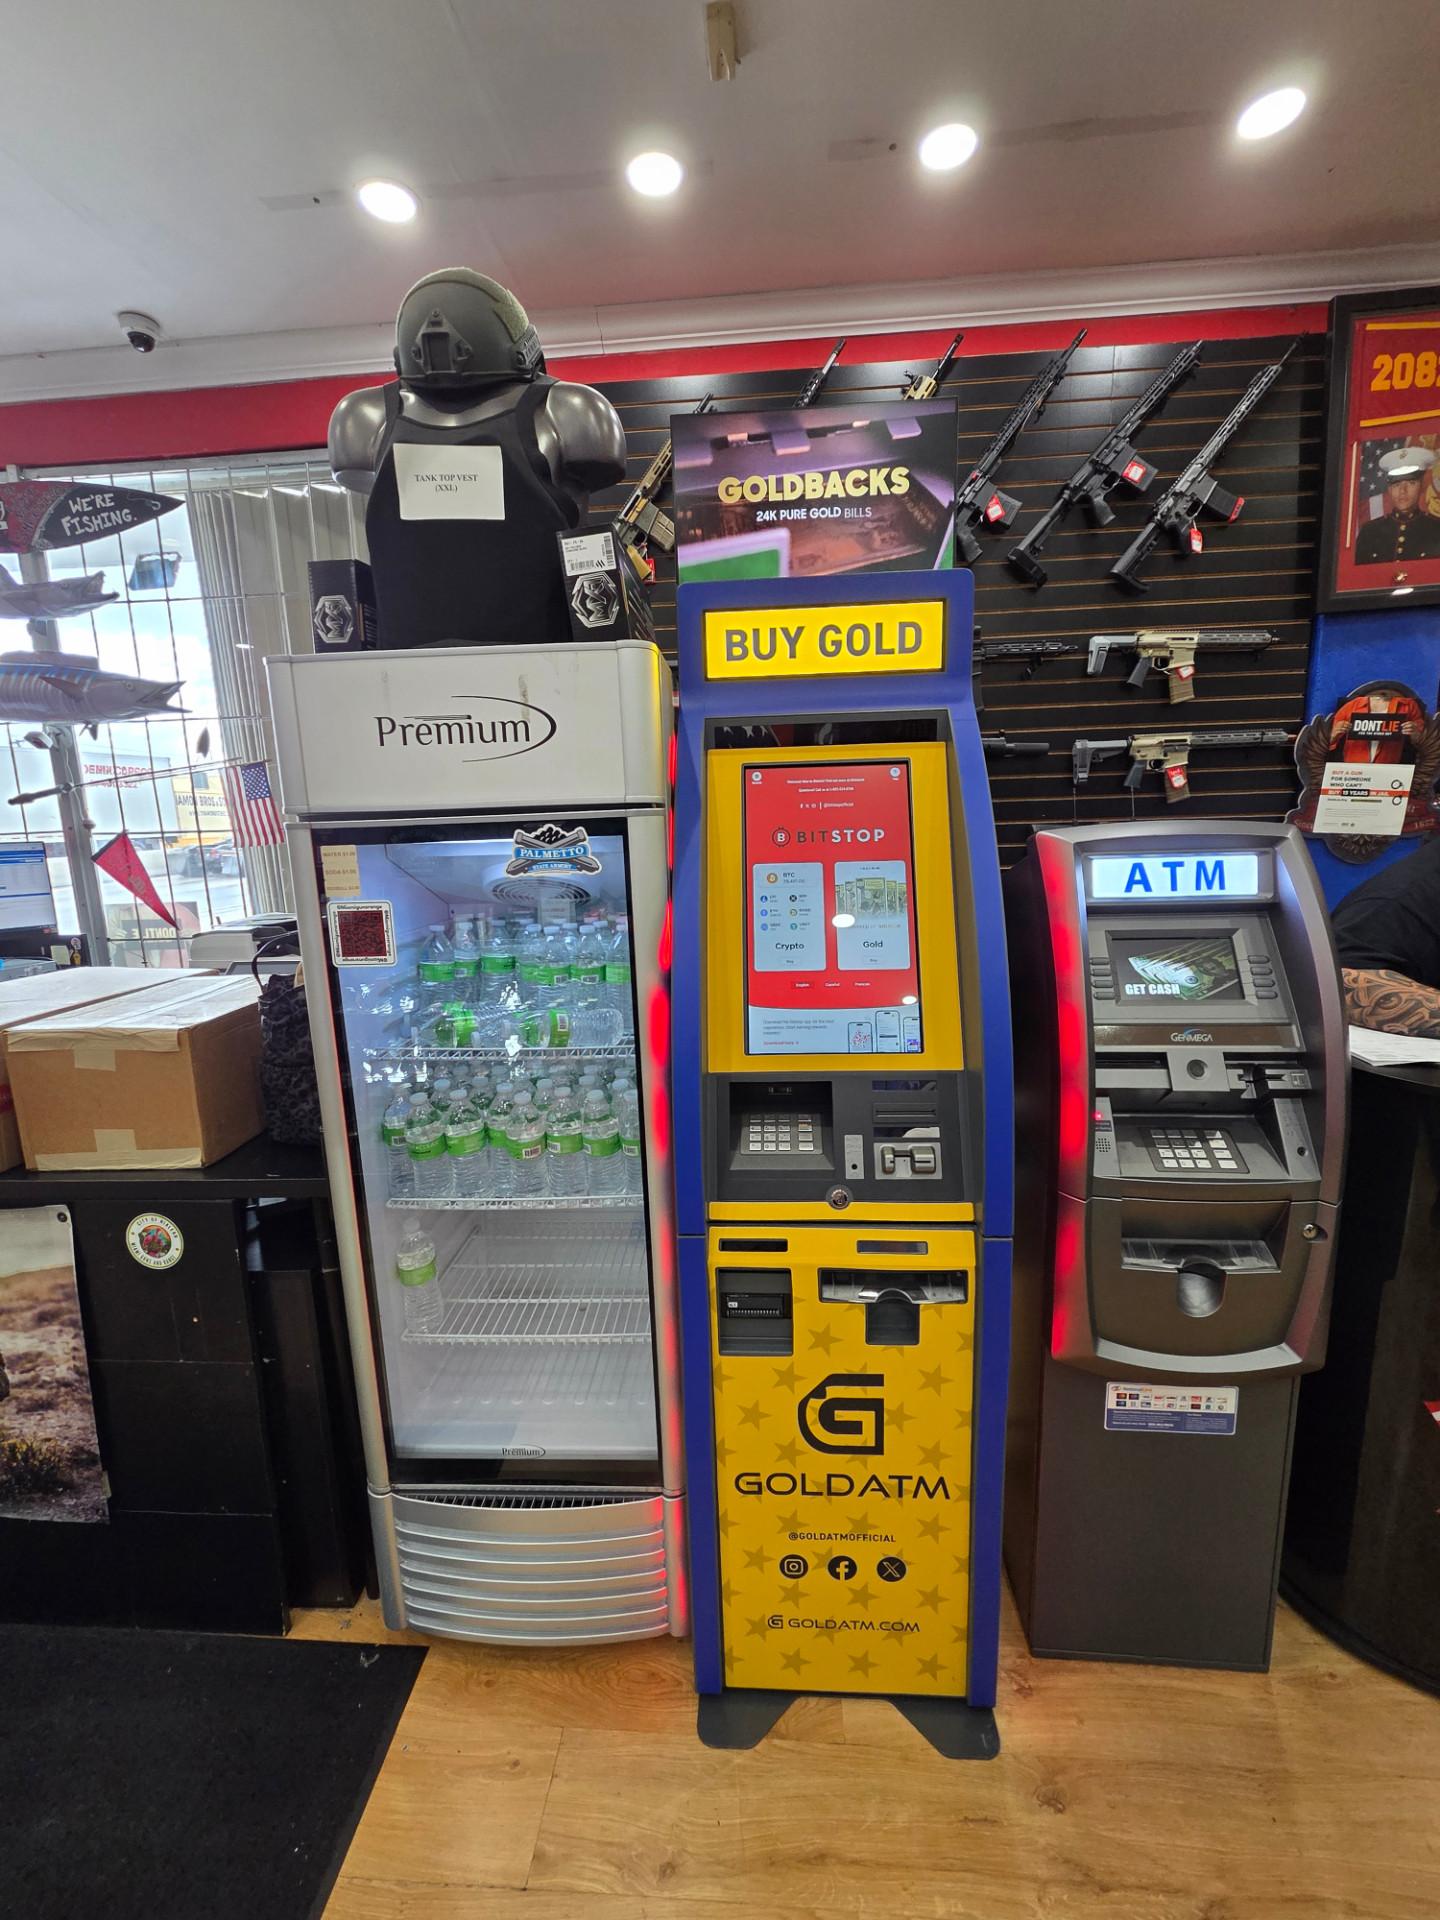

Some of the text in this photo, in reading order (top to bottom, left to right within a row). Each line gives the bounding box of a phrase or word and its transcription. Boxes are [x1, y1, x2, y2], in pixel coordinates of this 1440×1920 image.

[1371, 351, 1440, 392] 208
[414, 473, 479, 483] TANK TOP VEST
[717, 466, 911, 503] GOLDBACKS
[434, 483, 459, 493] (XXL)
[68, 493, 115, 514] WE'RE
[756, 507, 873, 522] 24K PURE GOLD BILLS
[60, 508, 138, 537] FISHING.
[724, 621, 923, 662] BUY GOLD
[374, 714, 531, 747] Premium
[797, 829, 885, 843] BITSTOP
[520, 846, 584, 858] PALMETTO
[1124, 859, 1226, 893] ATM
[775, 942, 805, 951] Crypto
[863, 941, 884, 949] Gold
[1125, 983, 1181, 996] GET CASH
[501, 1447, 541, 1457] Premium
[734, 1472, 951, 1500] GOLDATM
[788, 1531, 897, 1543] @GOLDATMOFFICIAL
[788, 1617, 921, 1633] GOLDATM.COM
